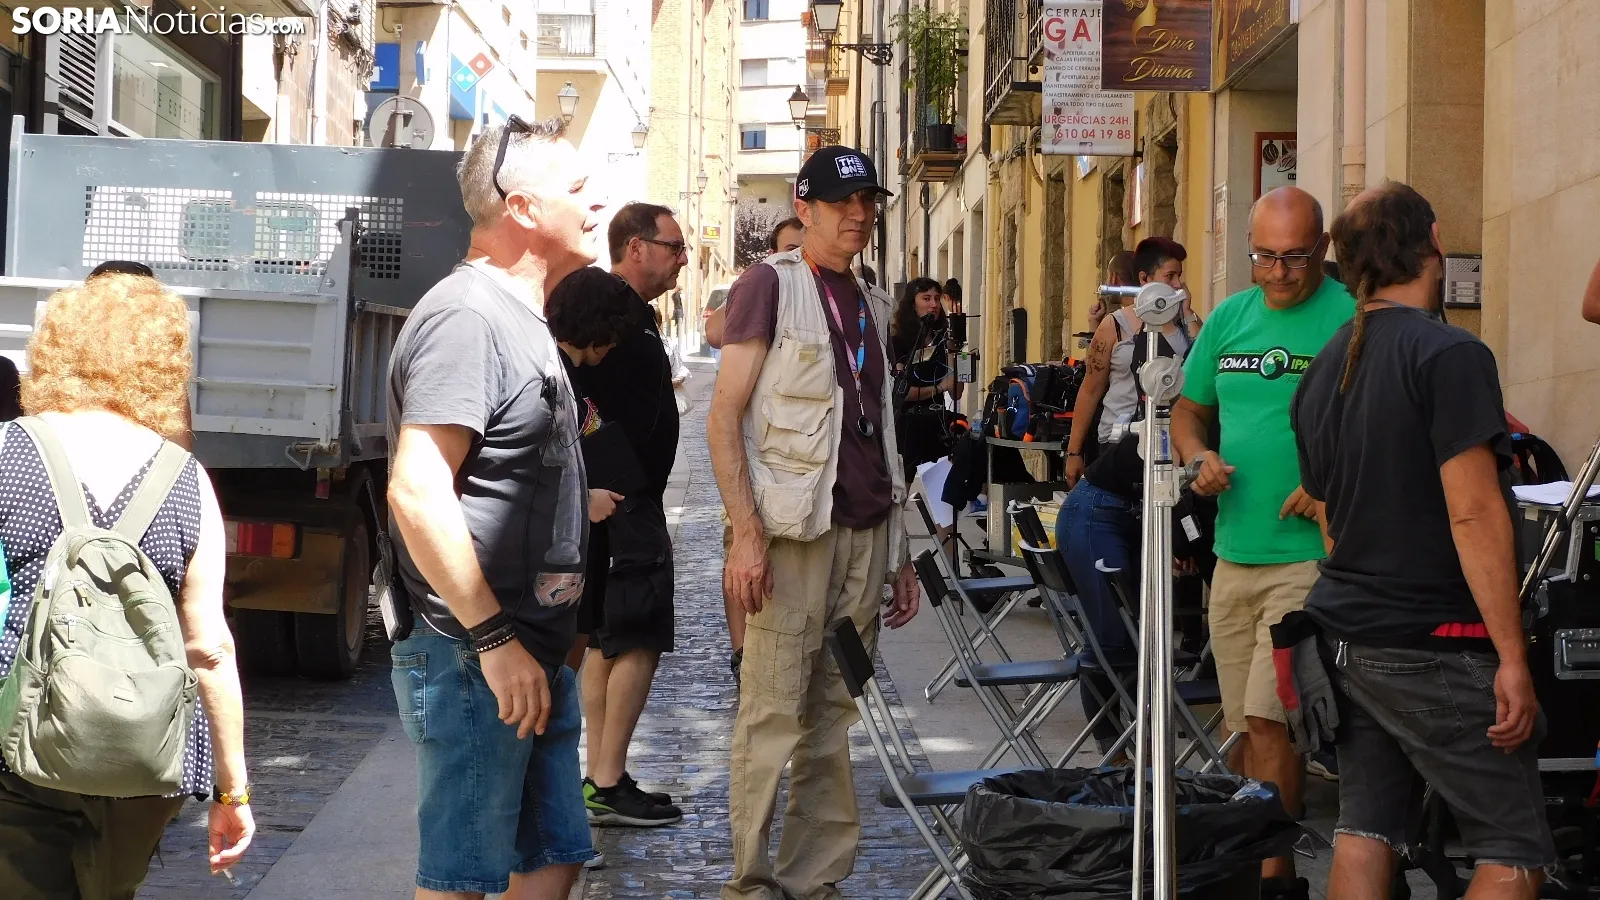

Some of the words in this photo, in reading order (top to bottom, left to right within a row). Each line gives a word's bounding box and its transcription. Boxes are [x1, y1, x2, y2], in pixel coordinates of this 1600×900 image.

[1044, 17, 1101, 42] GA
[1142, 28, 1197, 54] Diva
[1122, 56, 1196, 82] Divina
[1044, 115, 1107, 125] URGENCIAS
[1056, 128, 1078, 139] 610
[1081, 128, 1096, 139] 04
[1101, 129, 1114, 140] 19
[1117, 129, 1131, 140] 88
[1250, 357, 1260, 369] 2
[1290, 358, 1310, 370] IPA
